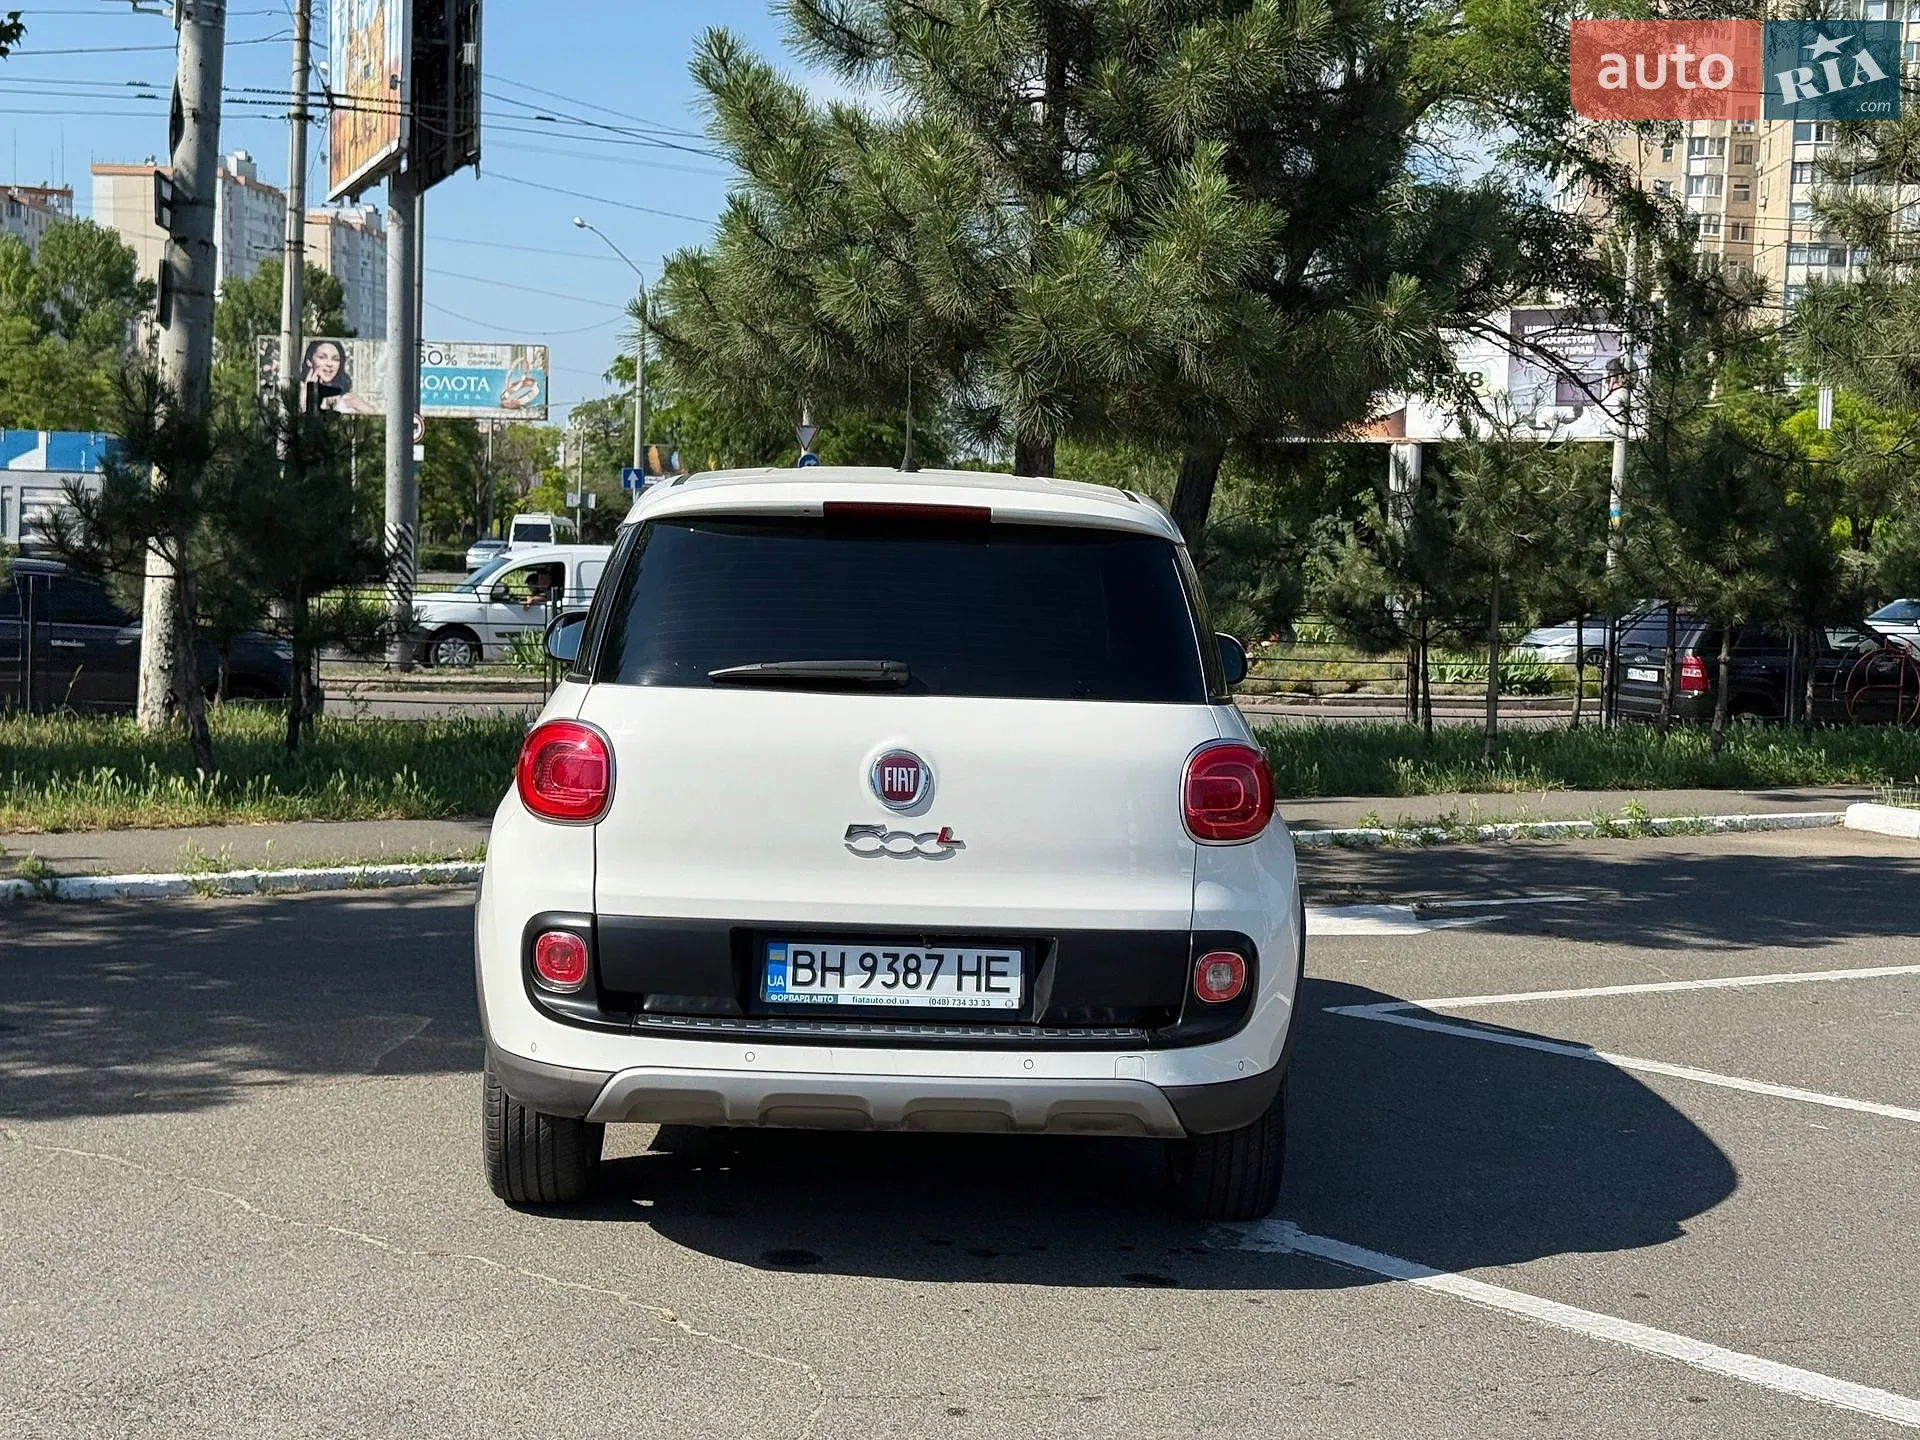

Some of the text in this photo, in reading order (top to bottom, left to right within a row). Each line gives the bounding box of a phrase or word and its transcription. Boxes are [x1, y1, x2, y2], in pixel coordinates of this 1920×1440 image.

[884, 767, 917, 792] FIAT
[843, 824, 966, 861] 500L
[791, 950, 1010, 993] BH 9387 HE
[767, 975, 785, 987] UA
[770, 994, 834, 1003] ФОРВАРД АВТО
[852, 995, 910, 1005] fiatauto.od.ua
[928, 997, 991, 1007] (048) 734 33 33
